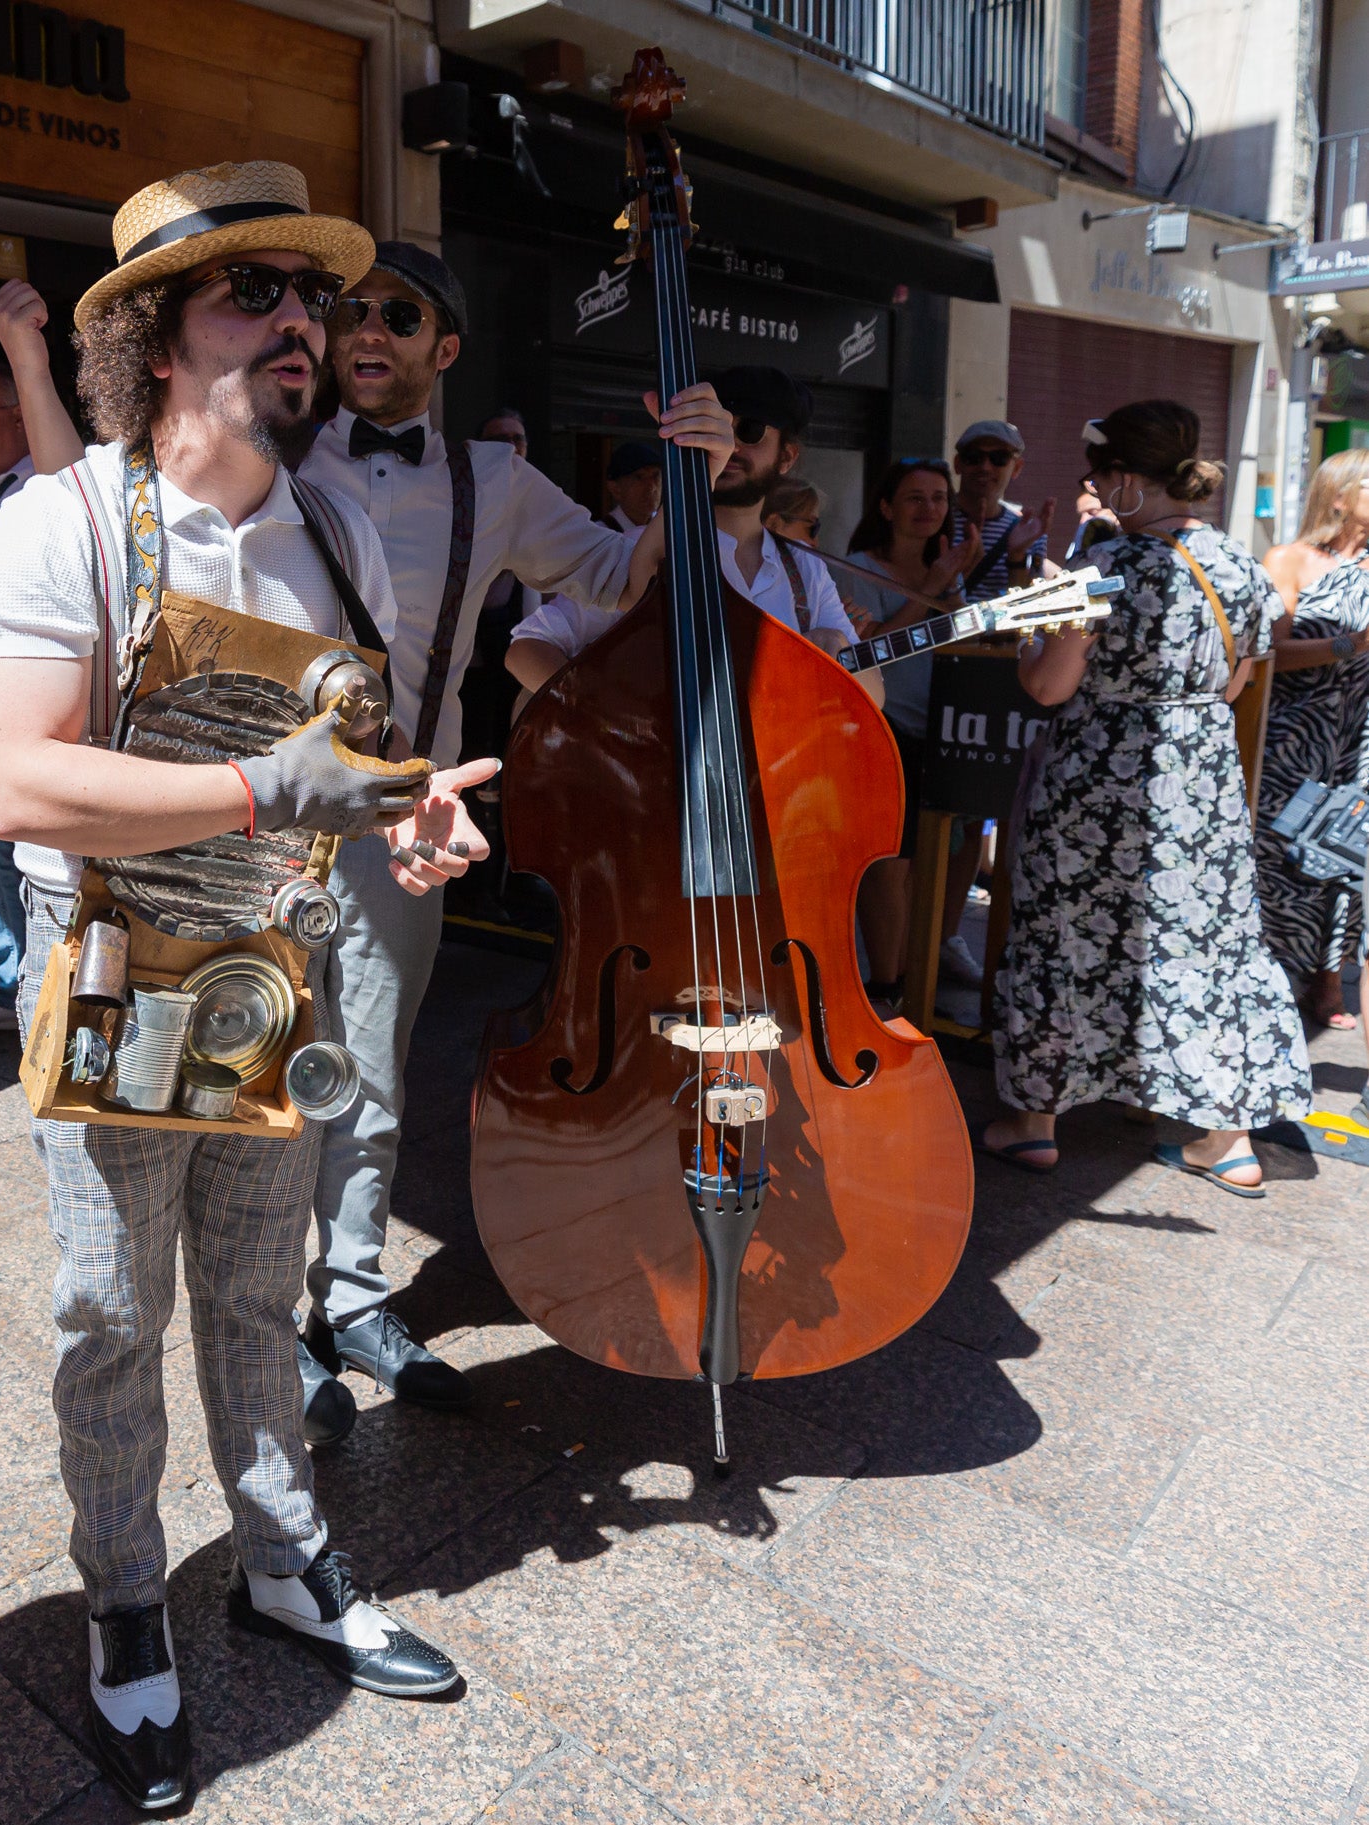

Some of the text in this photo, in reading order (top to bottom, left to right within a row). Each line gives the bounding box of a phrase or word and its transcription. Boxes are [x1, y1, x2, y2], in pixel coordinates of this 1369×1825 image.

[37, 112, 122, 150] VINOS
[724, 254, 786, 281] gin club
[577, 276, 631, 323] Schweppes
[738, 314, 800, 344] BISTRÓ
[941, 705, 988, 746] la
[939, 747, 1013, 765] VINOS
